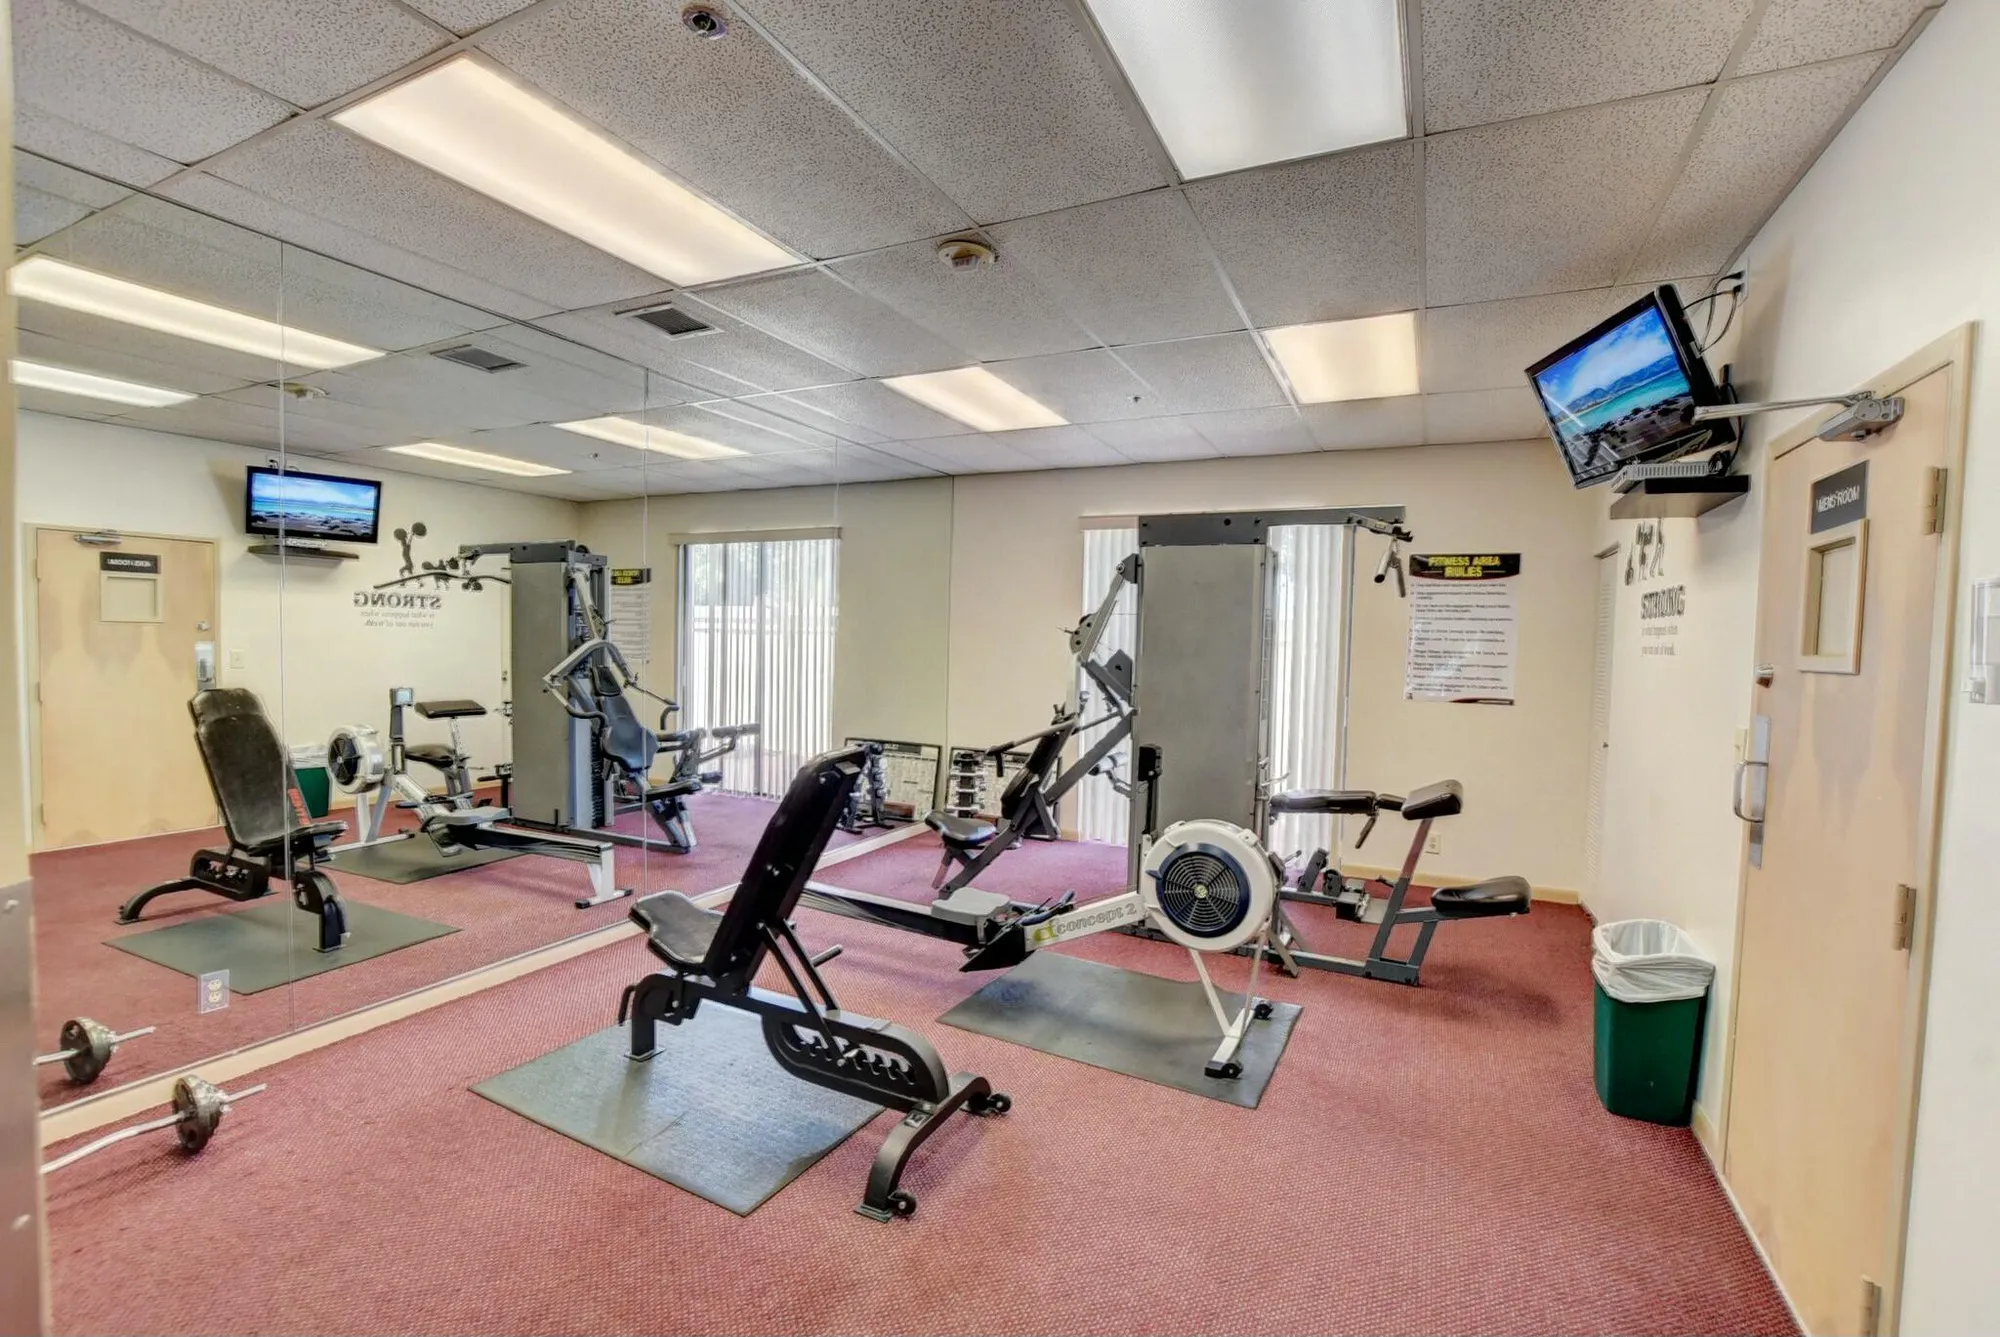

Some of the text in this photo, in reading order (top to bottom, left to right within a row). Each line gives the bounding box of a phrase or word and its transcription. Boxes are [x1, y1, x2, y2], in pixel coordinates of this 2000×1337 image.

[1428, 556, 1501, 567] FITNESS AREA
[1444, 566, 1482, 578] RULES
[1641, 584, 1686, 620] STRONG
[1056, 902, 1138, 935] concept 2
